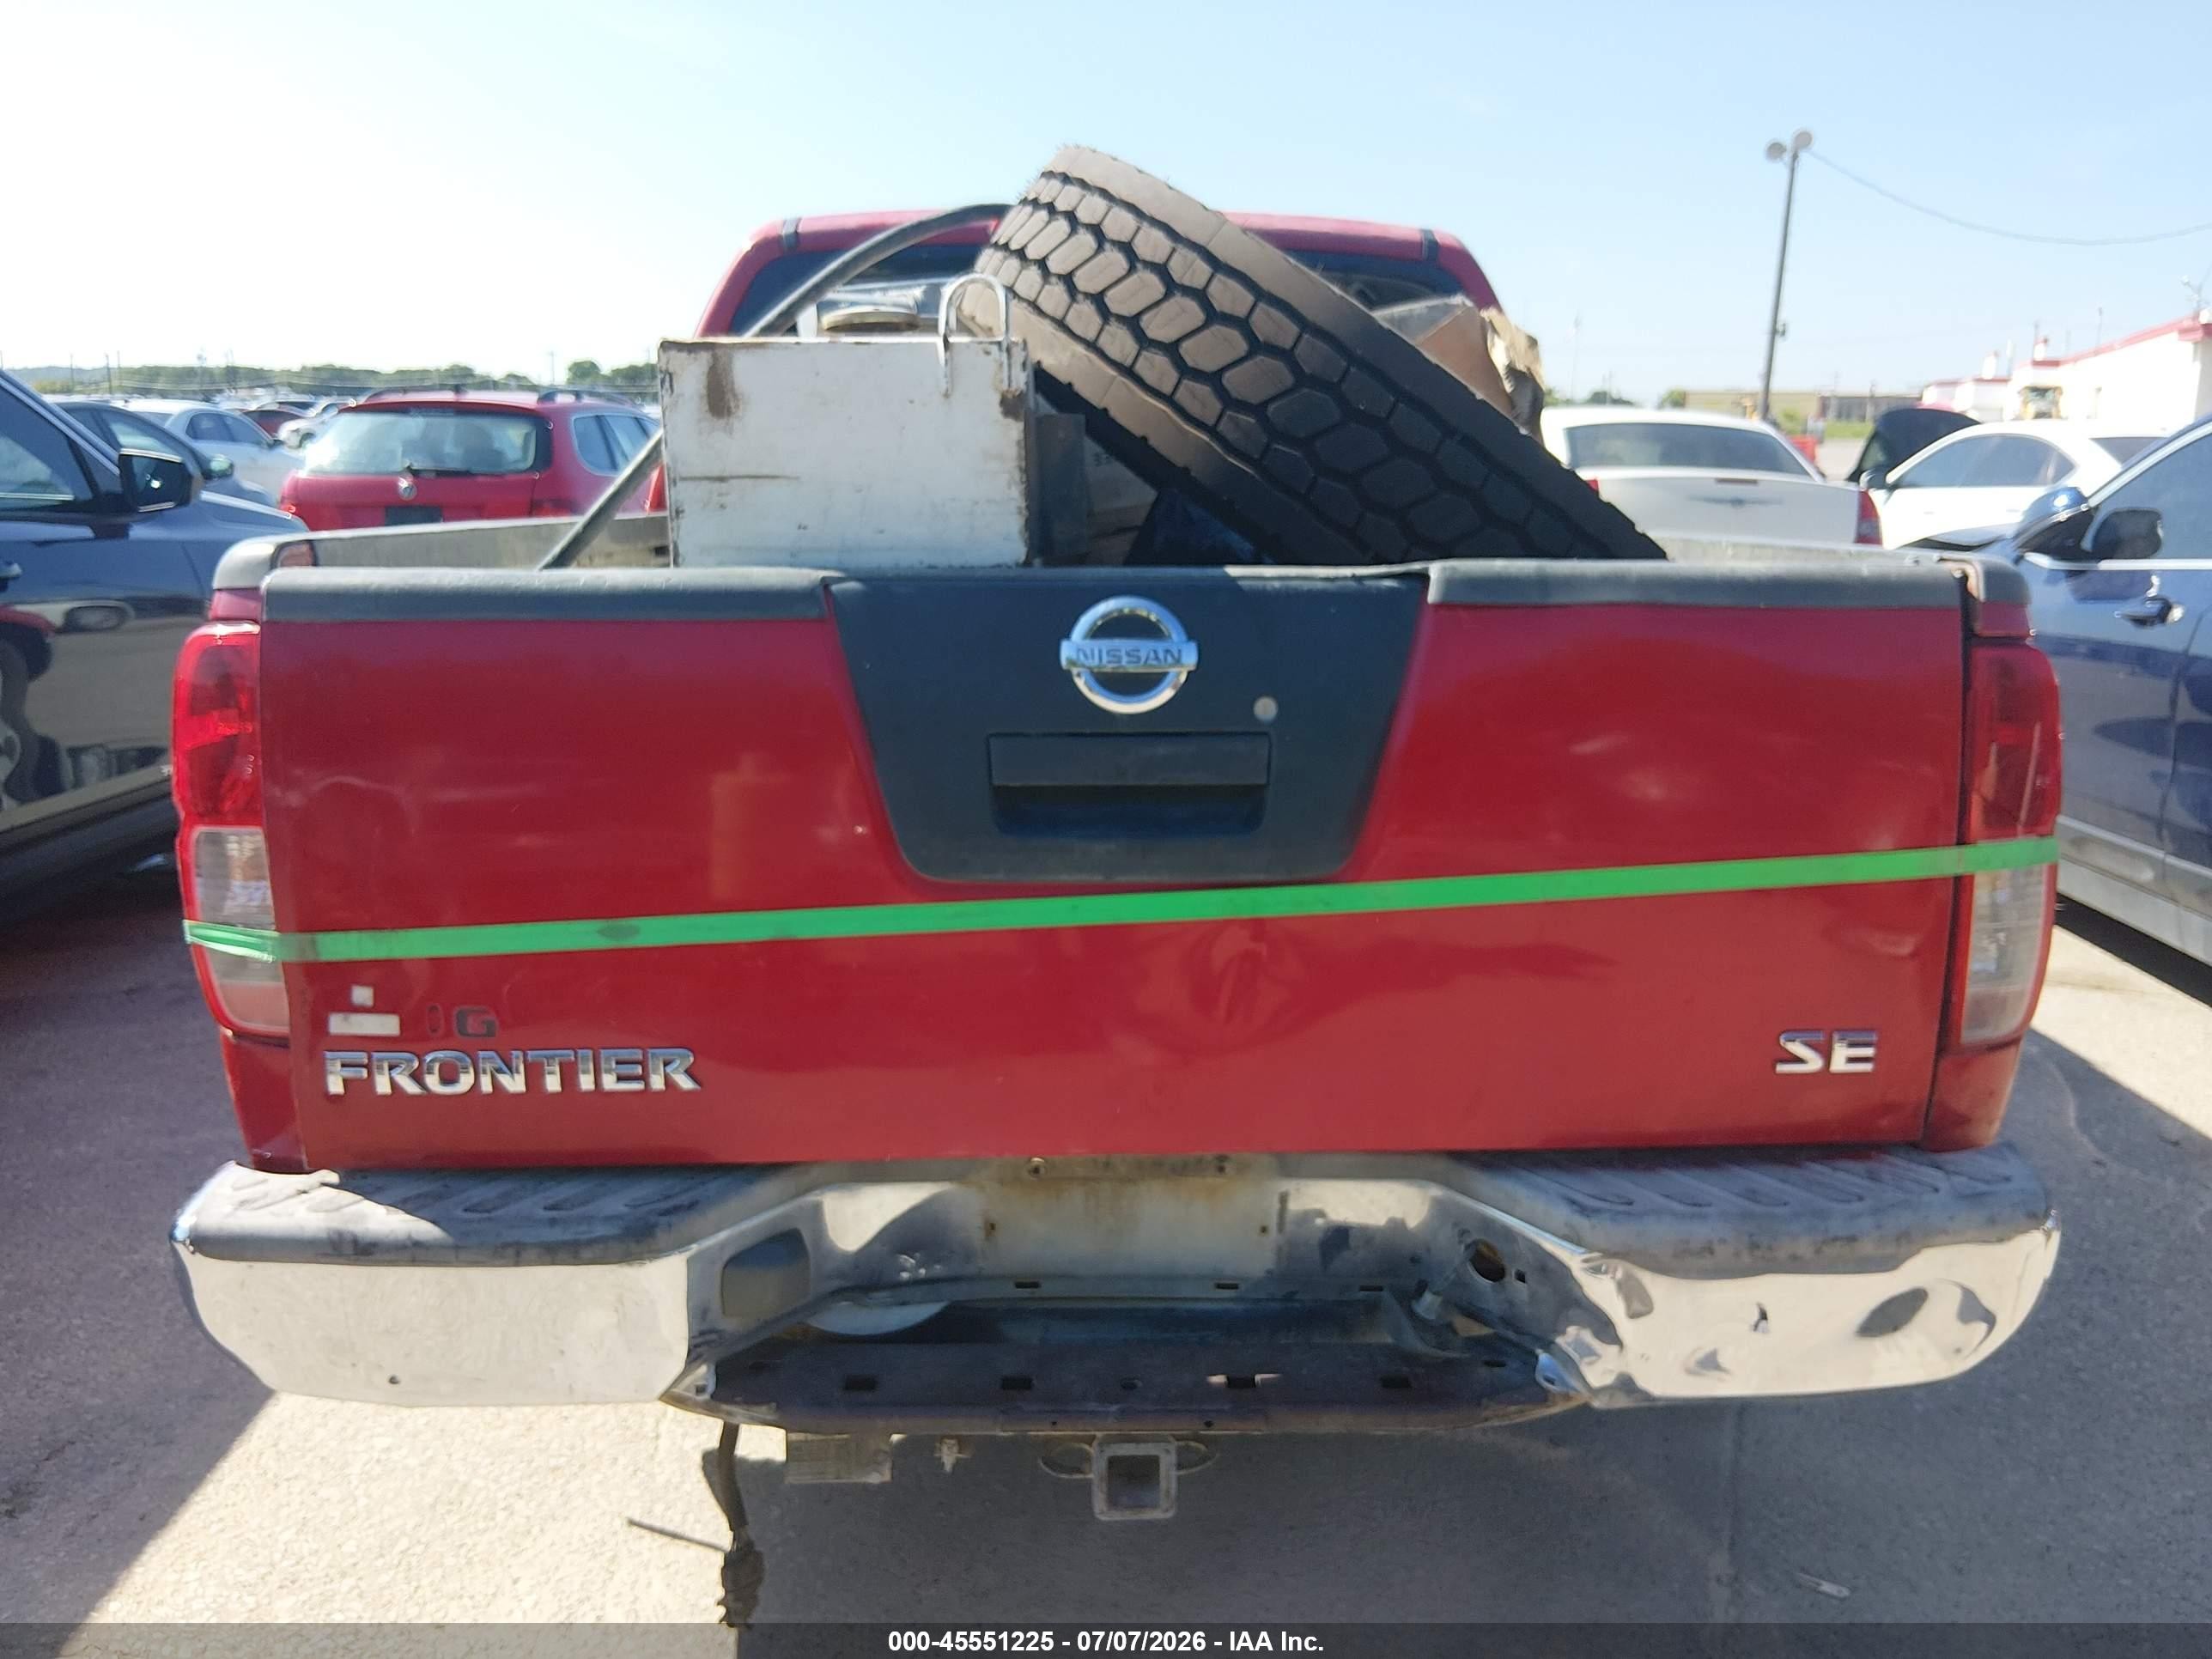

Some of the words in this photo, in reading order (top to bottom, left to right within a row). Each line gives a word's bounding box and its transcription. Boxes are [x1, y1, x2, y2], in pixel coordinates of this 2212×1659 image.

[1075, 647, 1182, 665] NISSAN
[324, 1048, 701, 1096] FRONTIER
[1775, 1030, 1878, 1074] SE
